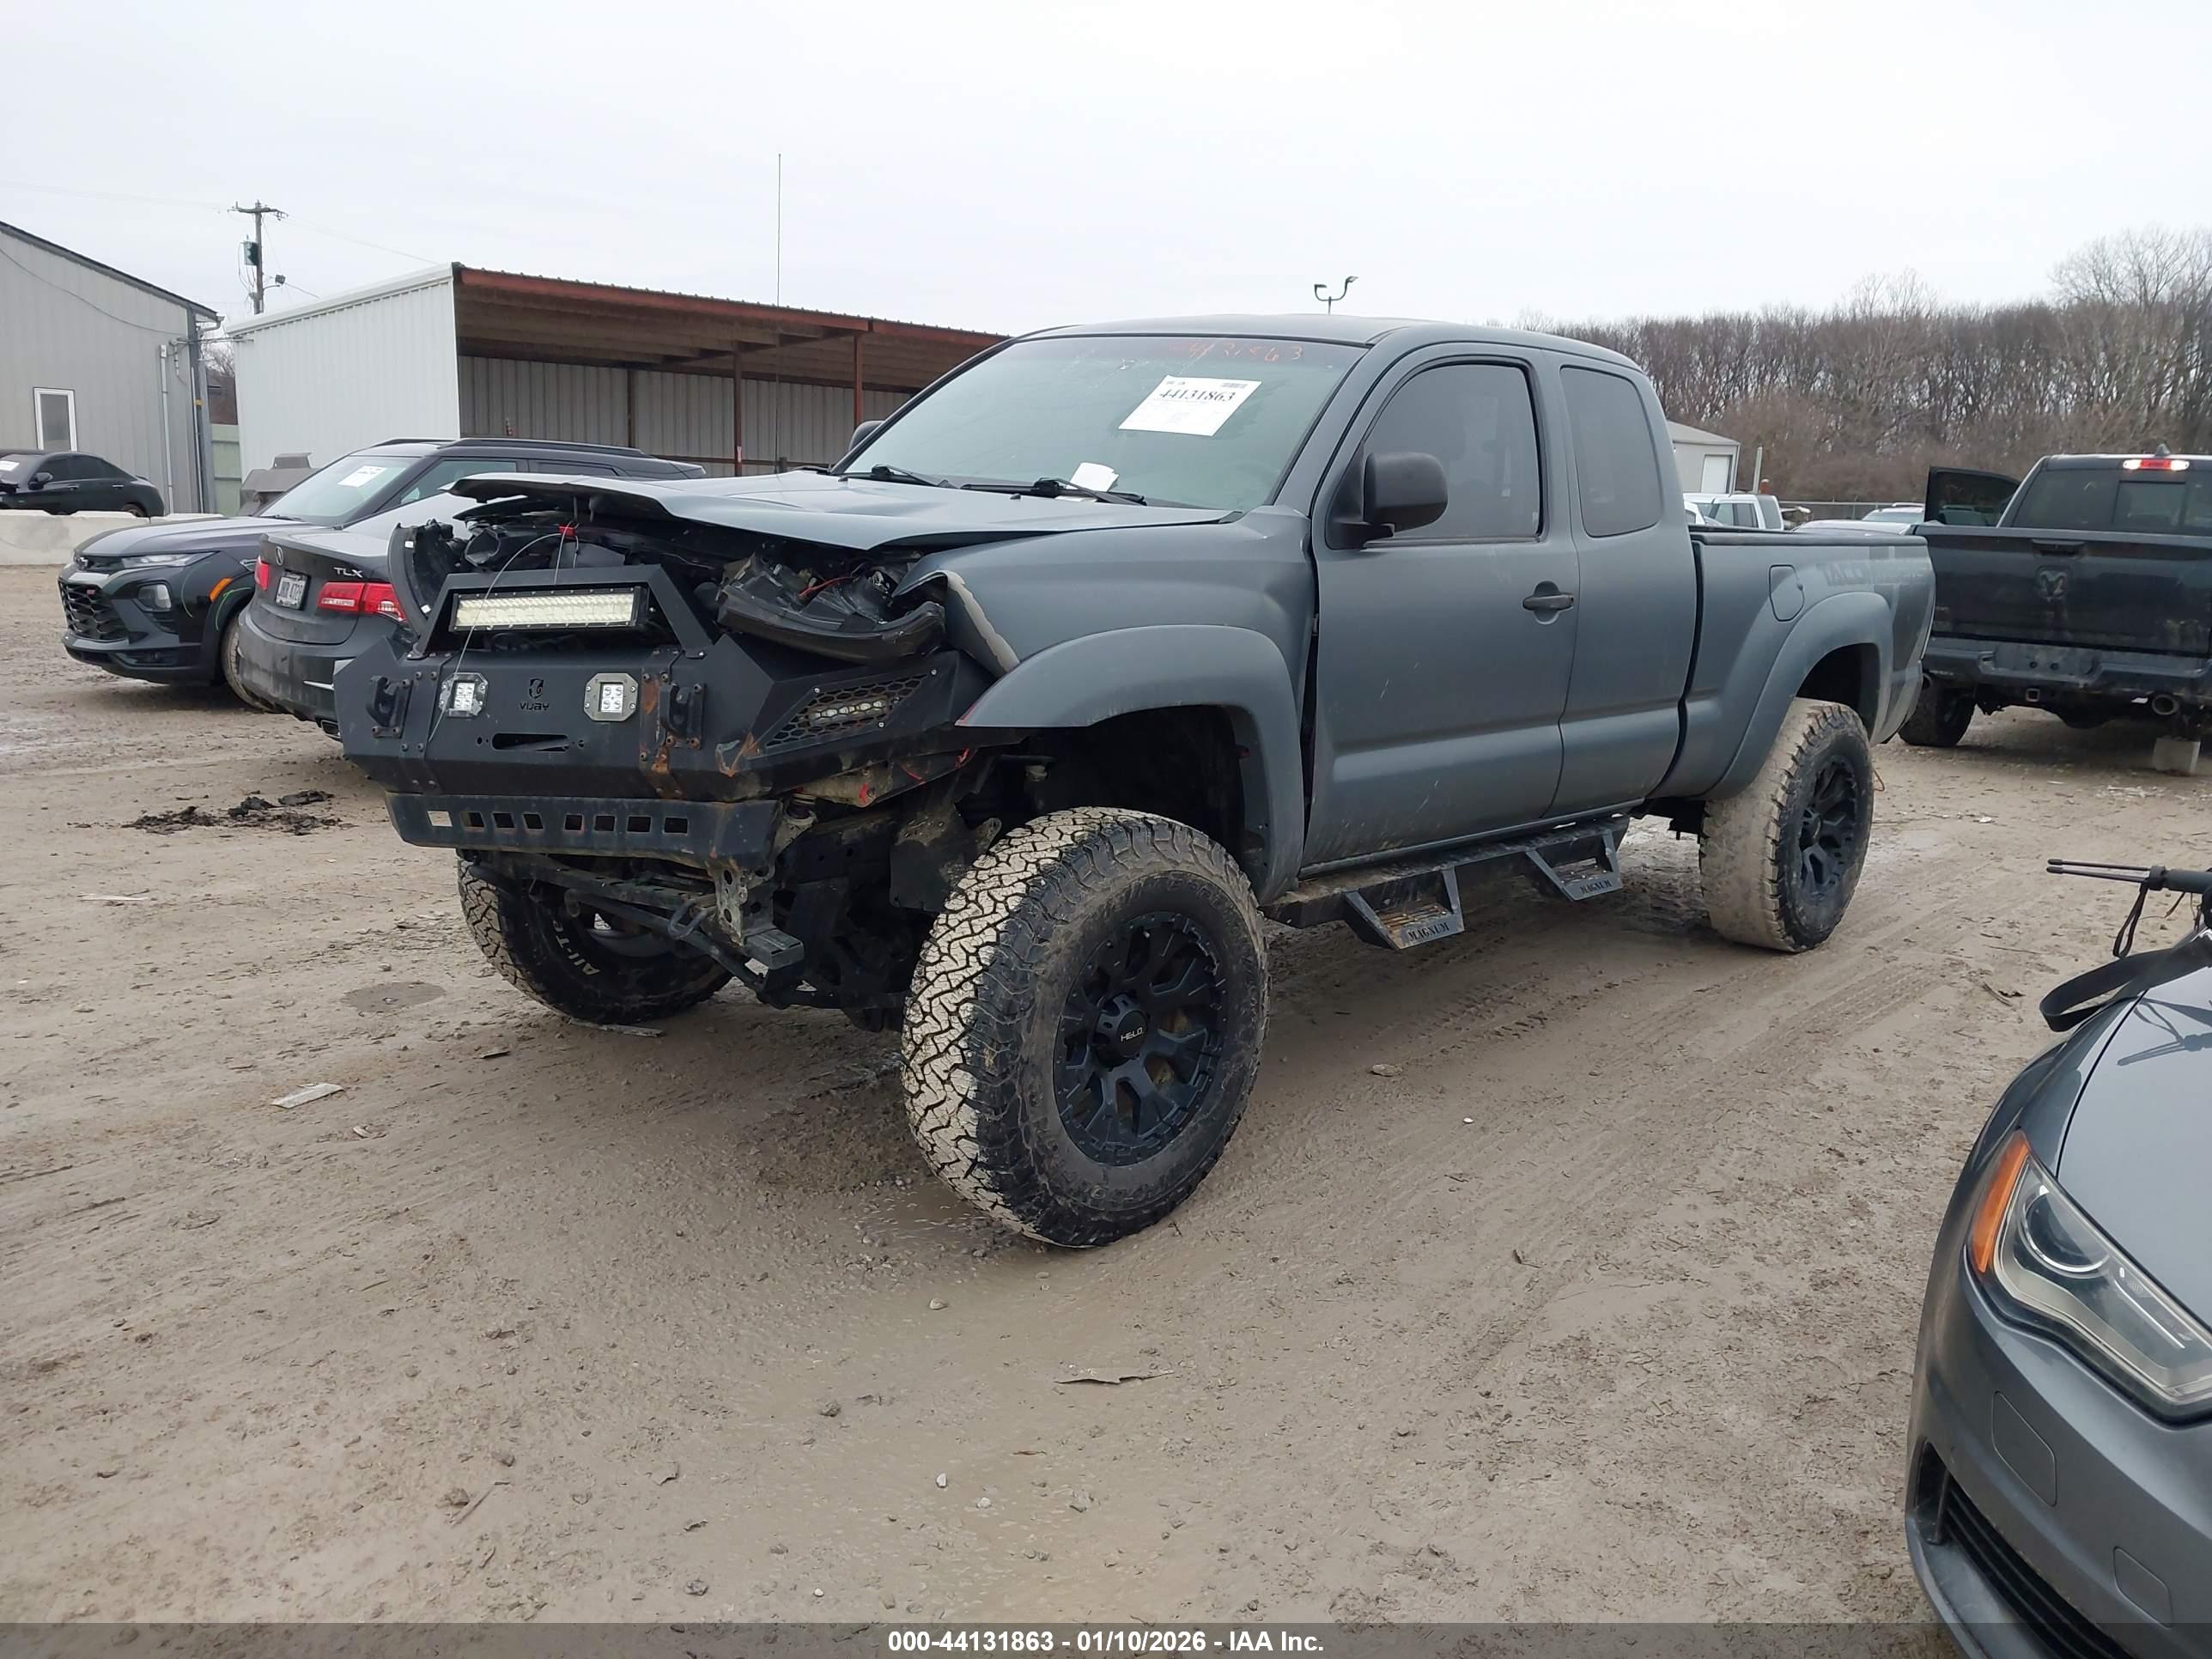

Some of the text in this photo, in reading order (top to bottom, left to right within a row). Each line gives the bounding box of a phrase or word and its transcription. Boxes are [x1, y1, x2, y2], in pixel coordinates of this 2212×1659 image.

[1159, 388, 1236, 402] 44131863
[333, 567, 363, 579] TLX
[1580, 879, 1612, 894] MAGNUM
[1408, 922, 1449, 941] MAGNUM
[1121, 1026, 1143, 1042] HELO
